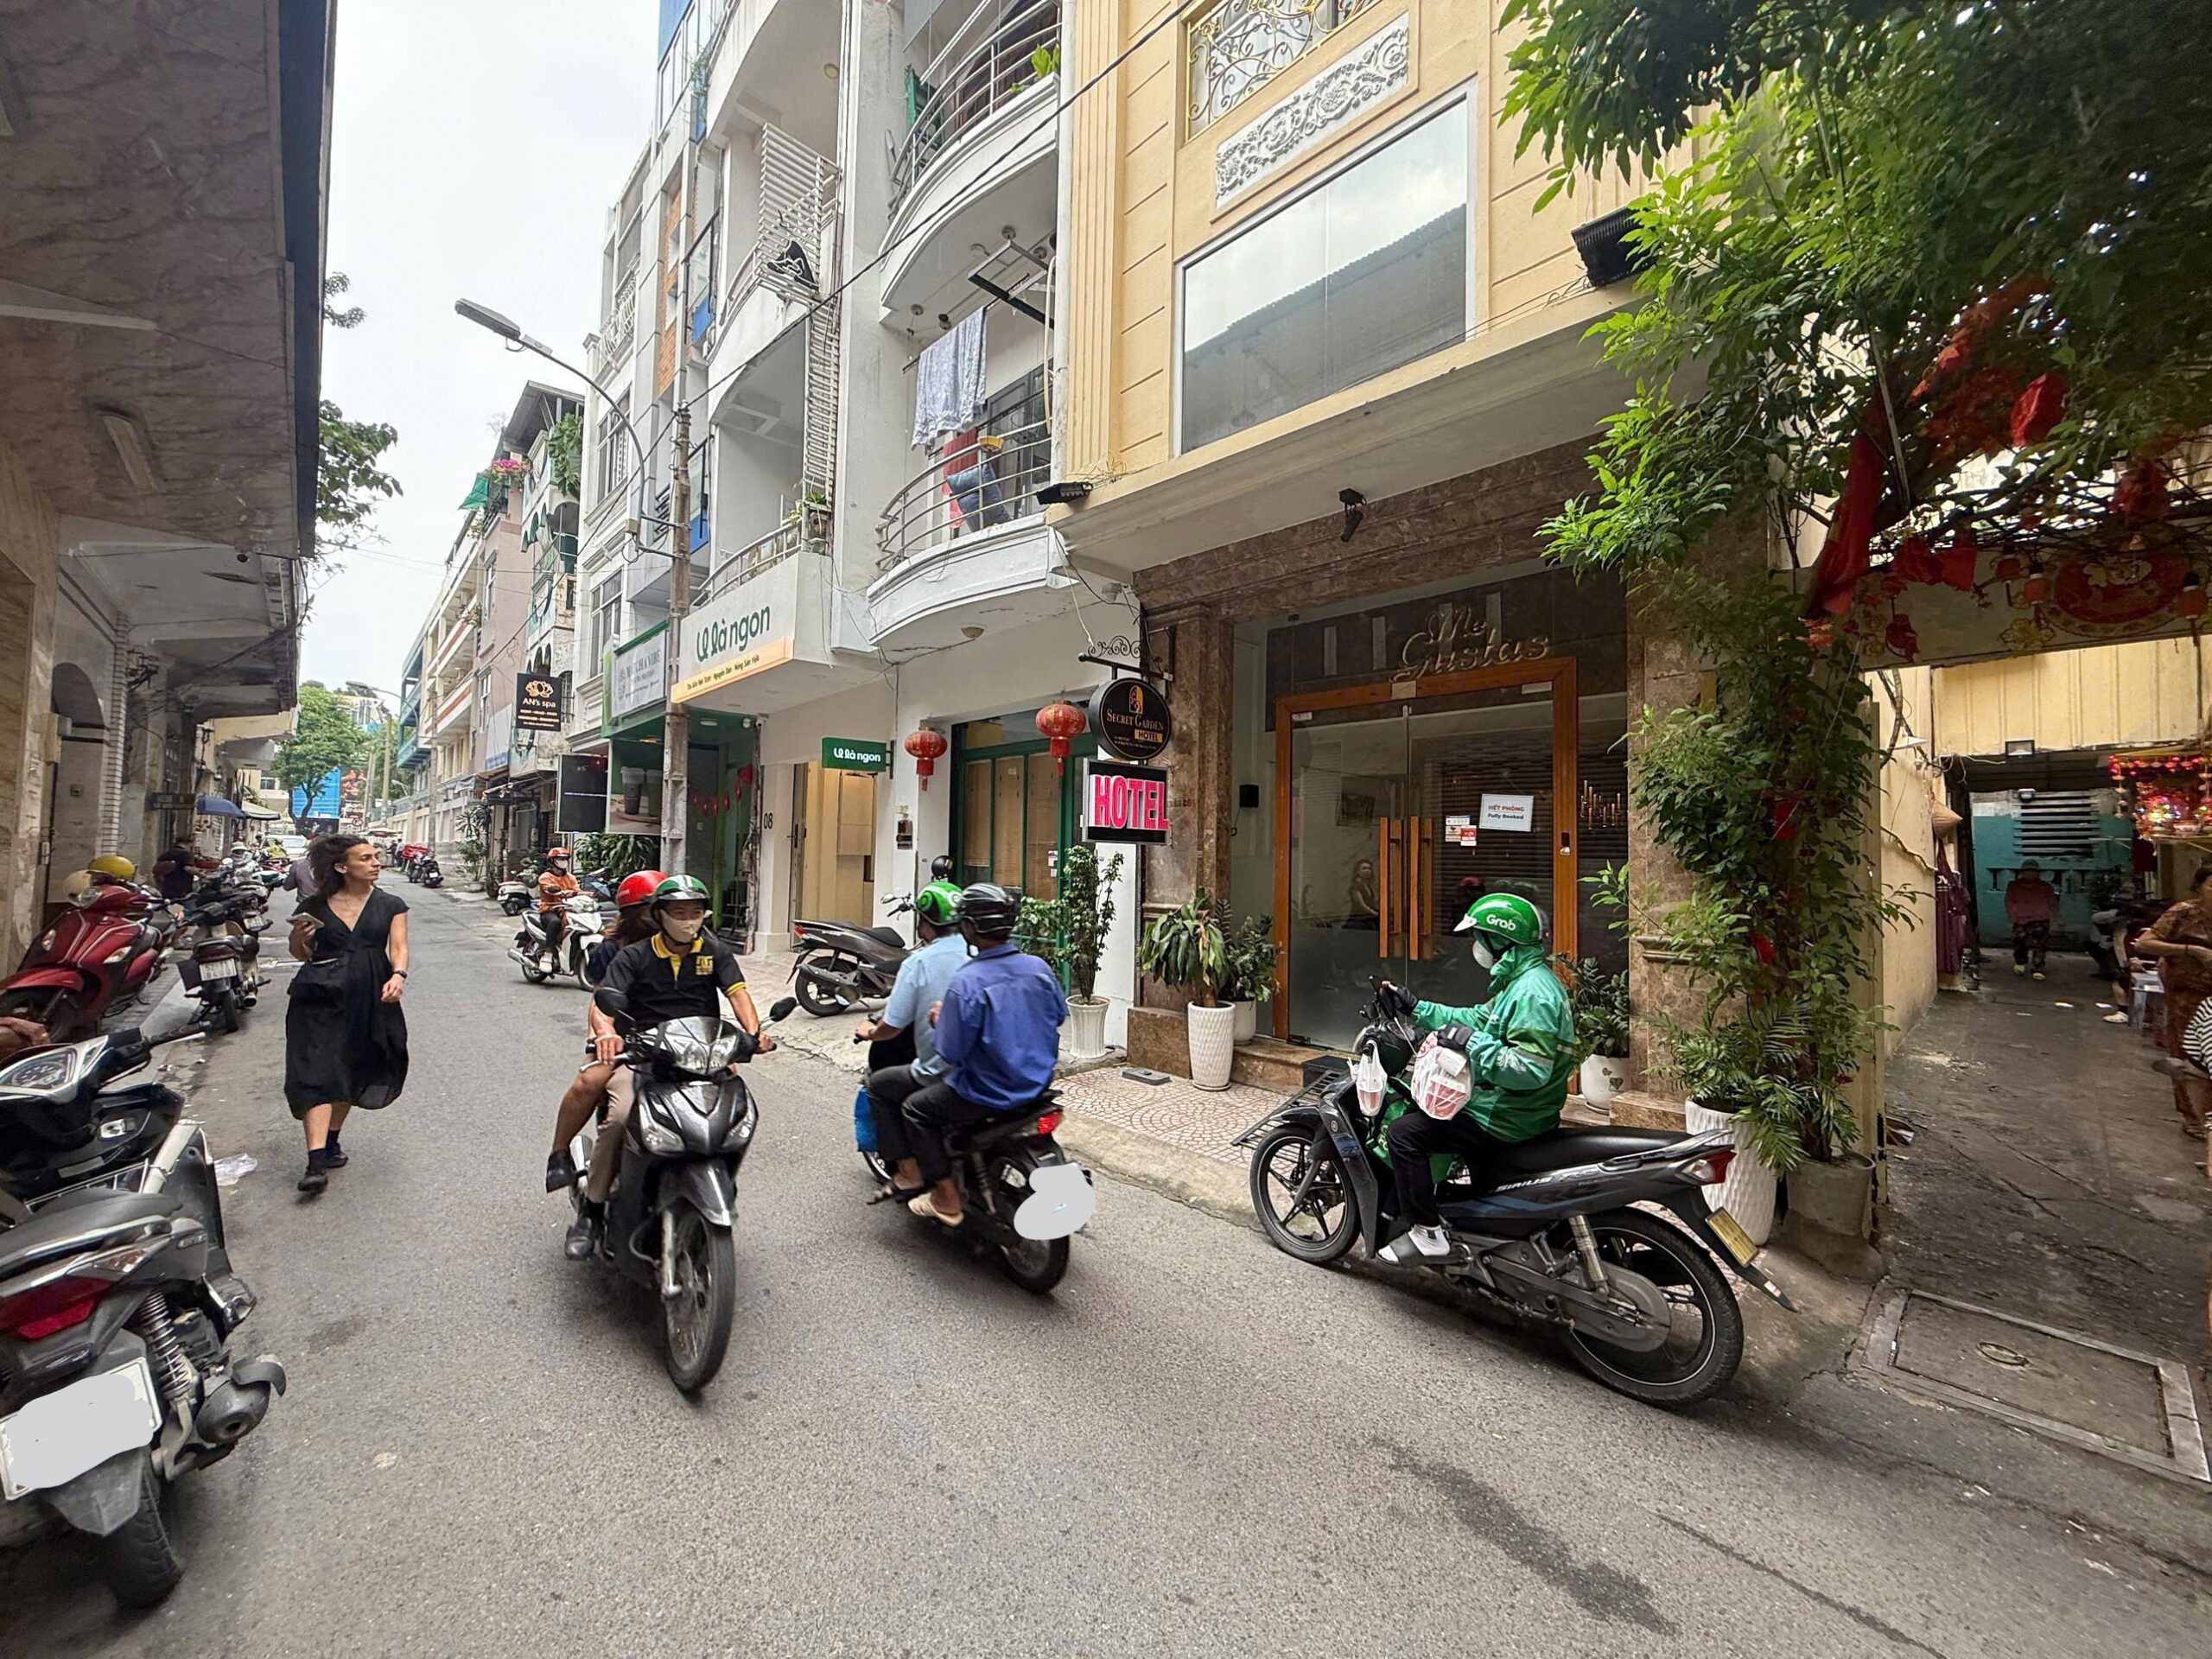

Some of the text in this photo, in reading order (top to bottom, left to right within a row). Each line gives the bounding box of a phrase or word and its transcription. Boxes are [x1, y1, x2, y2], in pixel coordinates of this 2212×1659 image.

[729, 606, 770, 652] ngon
[1389, 628, 1548, 683] Gustas
[522, 697, 540, 707] AN's
[1107, 709, 1164, 732] SECRET GARDEN
[1138, 731, 1159, 741] HOTEL
[856, 753, 881, 763] ngon
[1092, 774, 1170, 831] HOTEL
[764, 812, 773, 830] 08
[1485, 913, 1516, 931] Grab
[1495, 1176, 1554, 1192] SIRIUS
